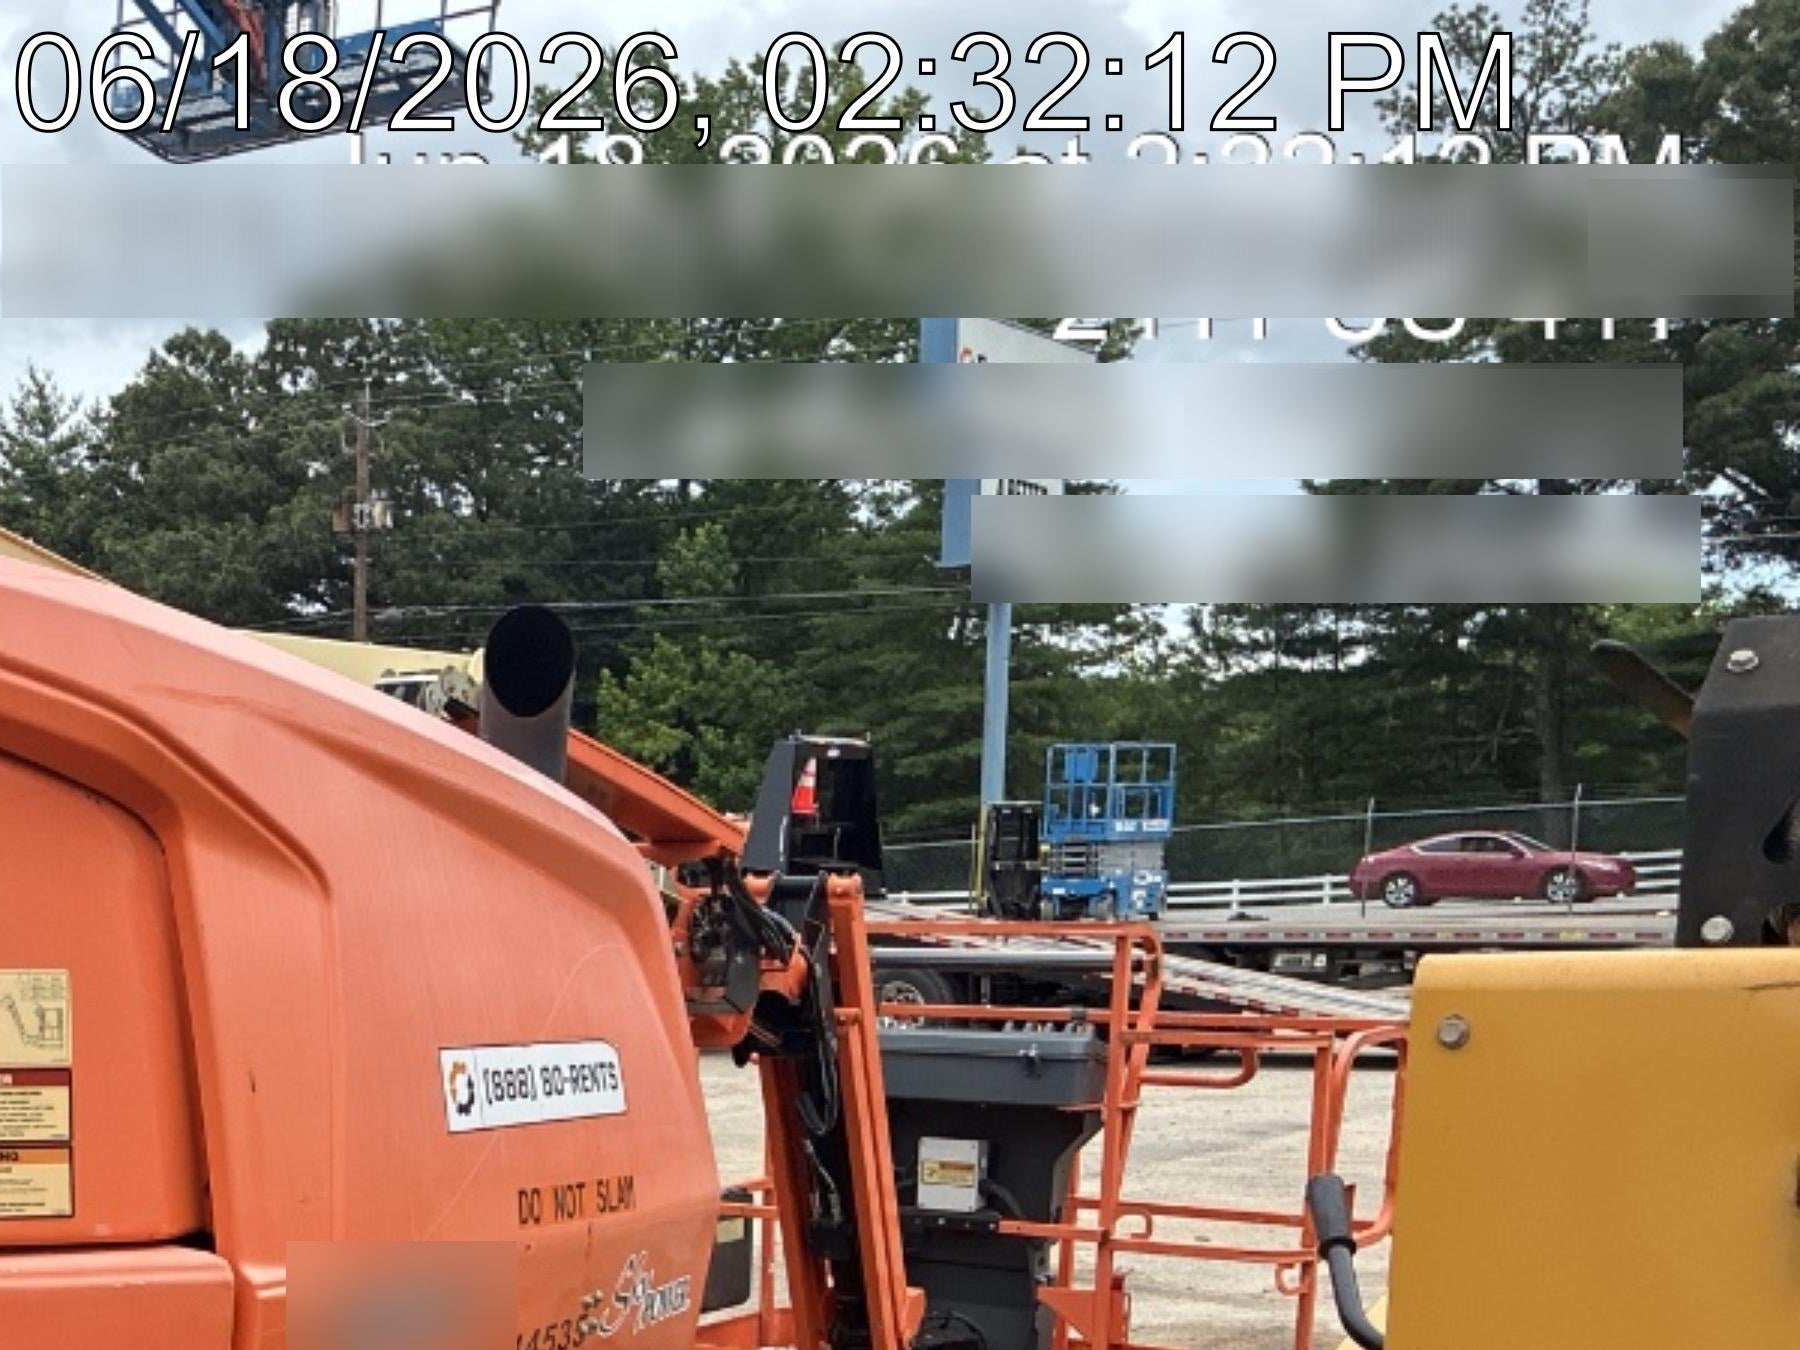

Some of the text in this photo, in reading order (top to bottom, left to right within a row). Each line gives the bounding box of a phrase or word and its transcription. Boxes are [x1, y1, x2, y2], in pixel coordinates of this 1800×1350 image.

[518, 1175, 636, 1225] DO NOT SLAM
